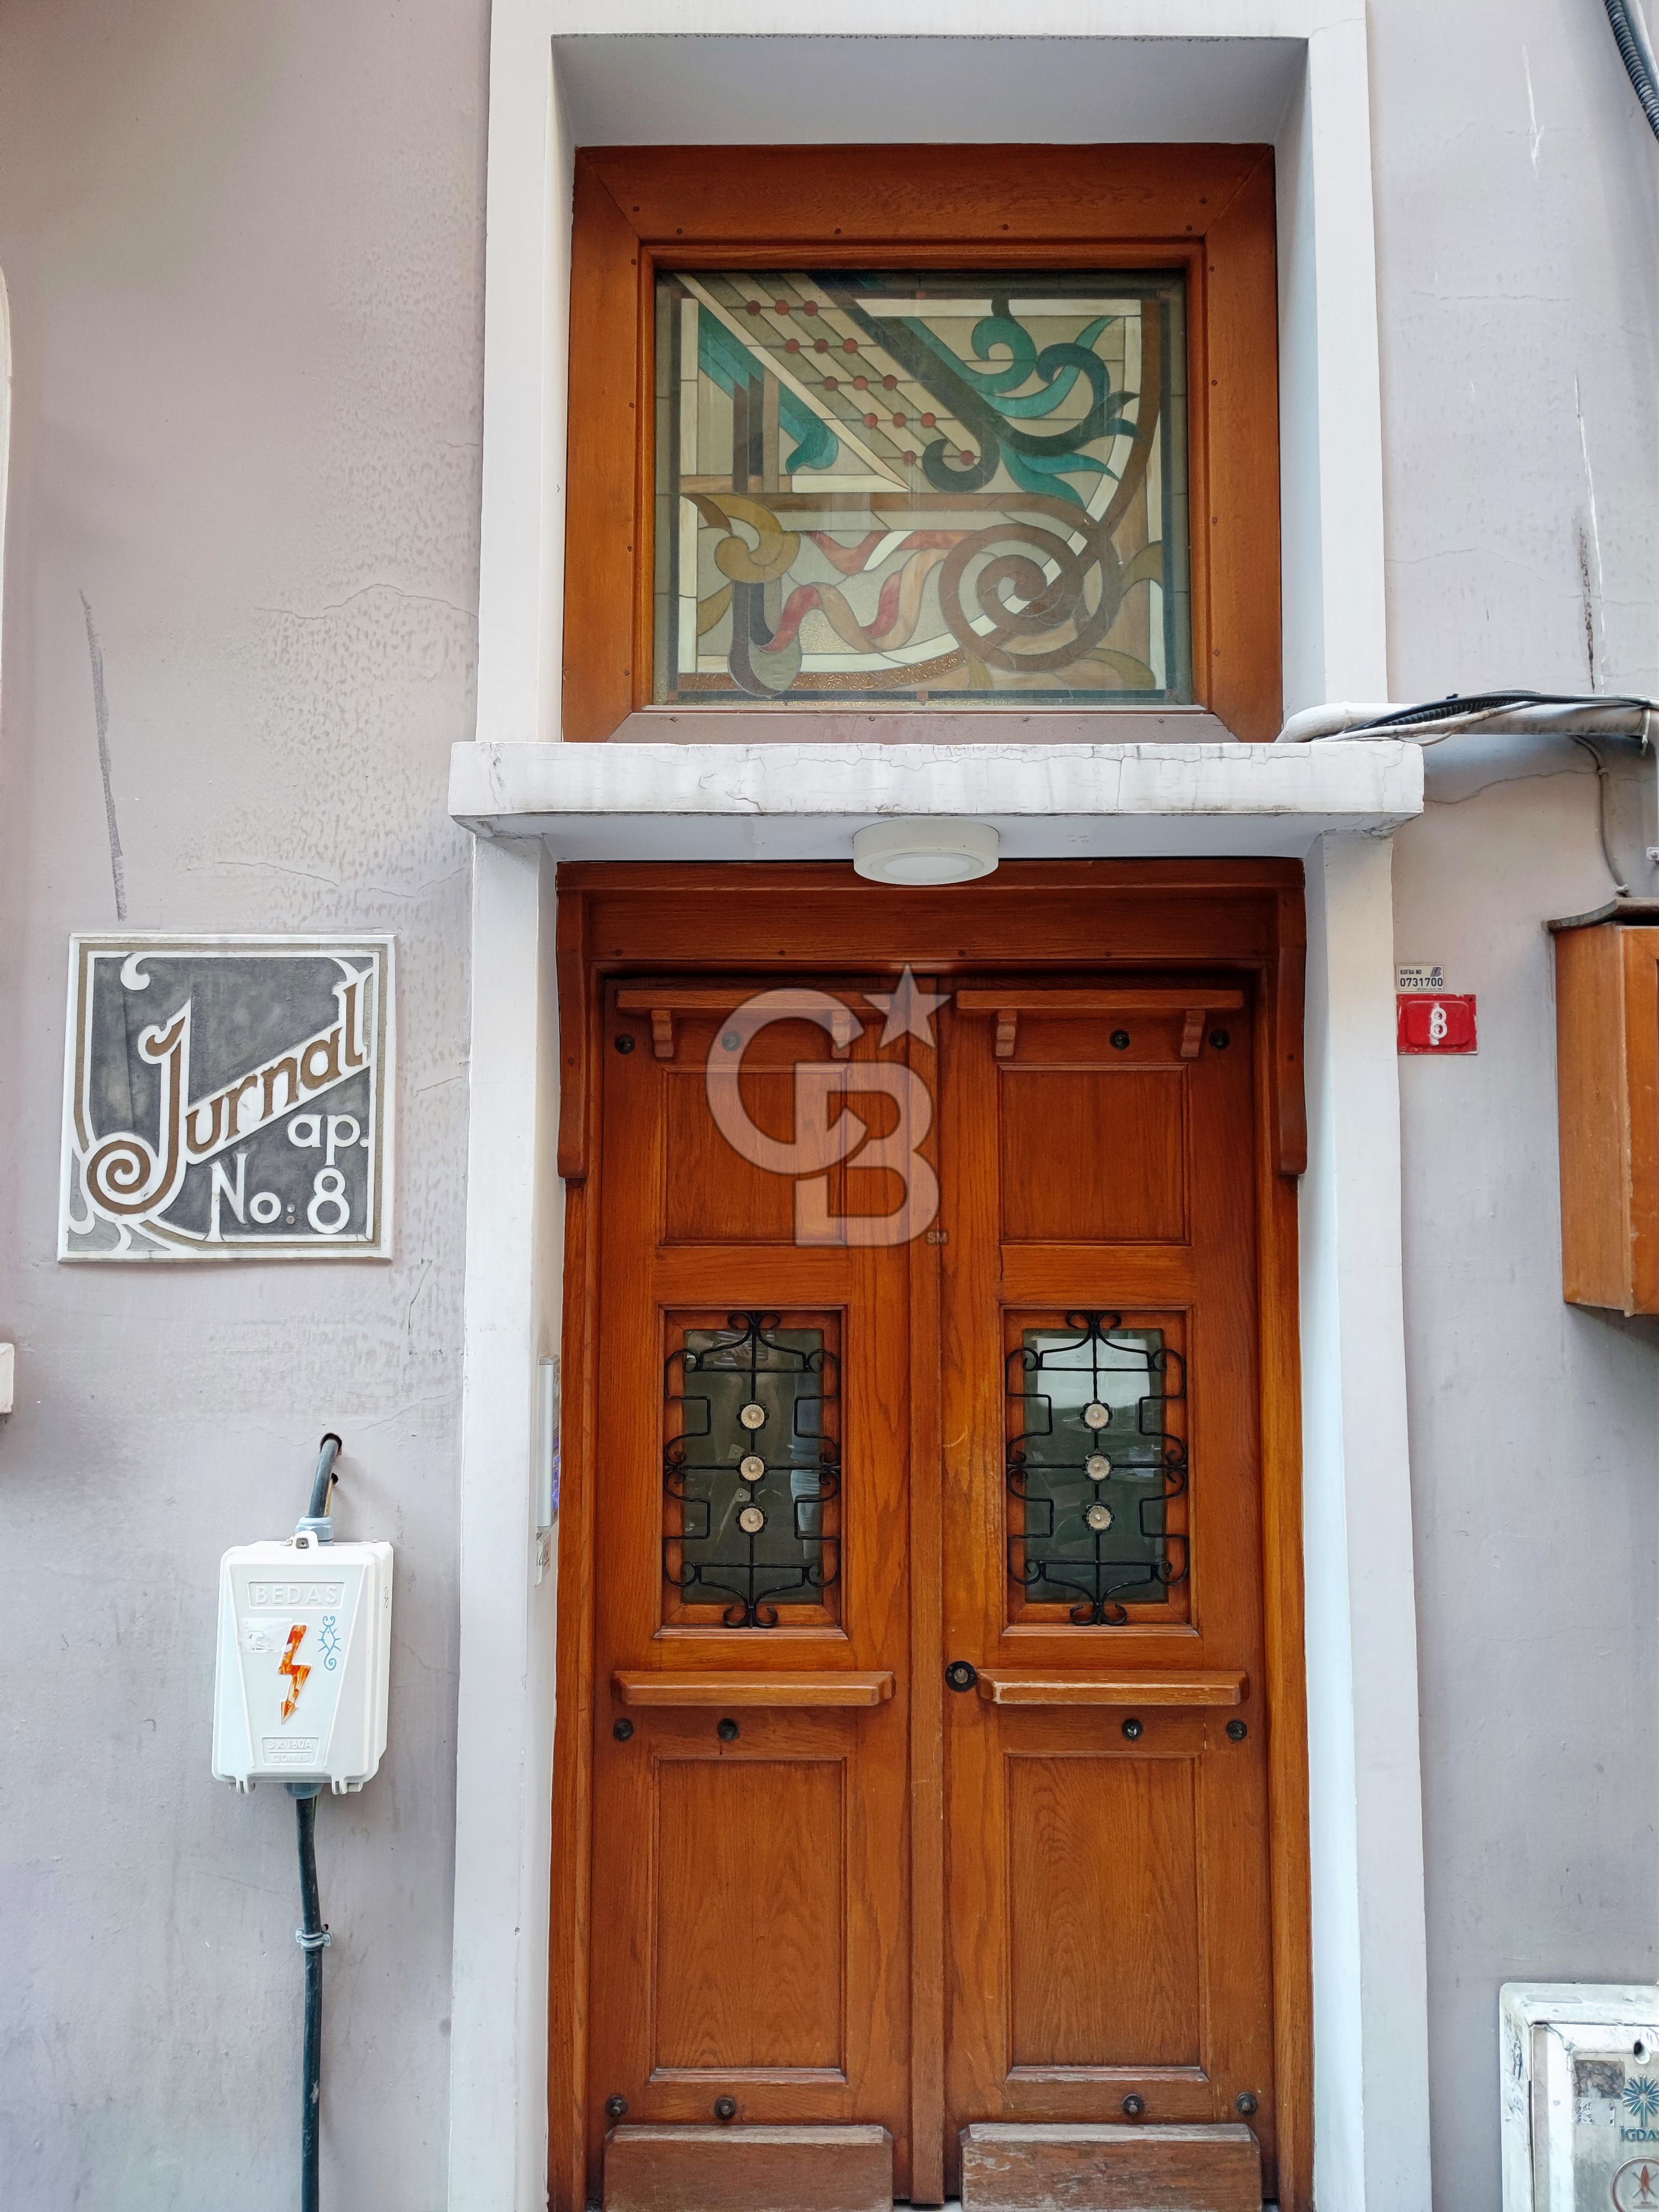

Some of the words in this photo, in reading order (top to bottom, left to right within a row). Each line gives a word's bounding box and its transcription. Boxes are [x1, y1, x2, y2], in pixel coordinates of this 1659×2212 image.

[1400, 978, 1443, 987] 0731700
[1430, 1008, 1448, 1039] 8
[87, 982, 363, 1214] Jurnal
[287, 1114, 369, 1166] ap.
[307, 1167, 350, 1234] 8
[255, 1585, 337, 1606] BEDAŞ
[268, 1739, 274, 1749] 3
[287, 1739, 313, 1749] 160A
